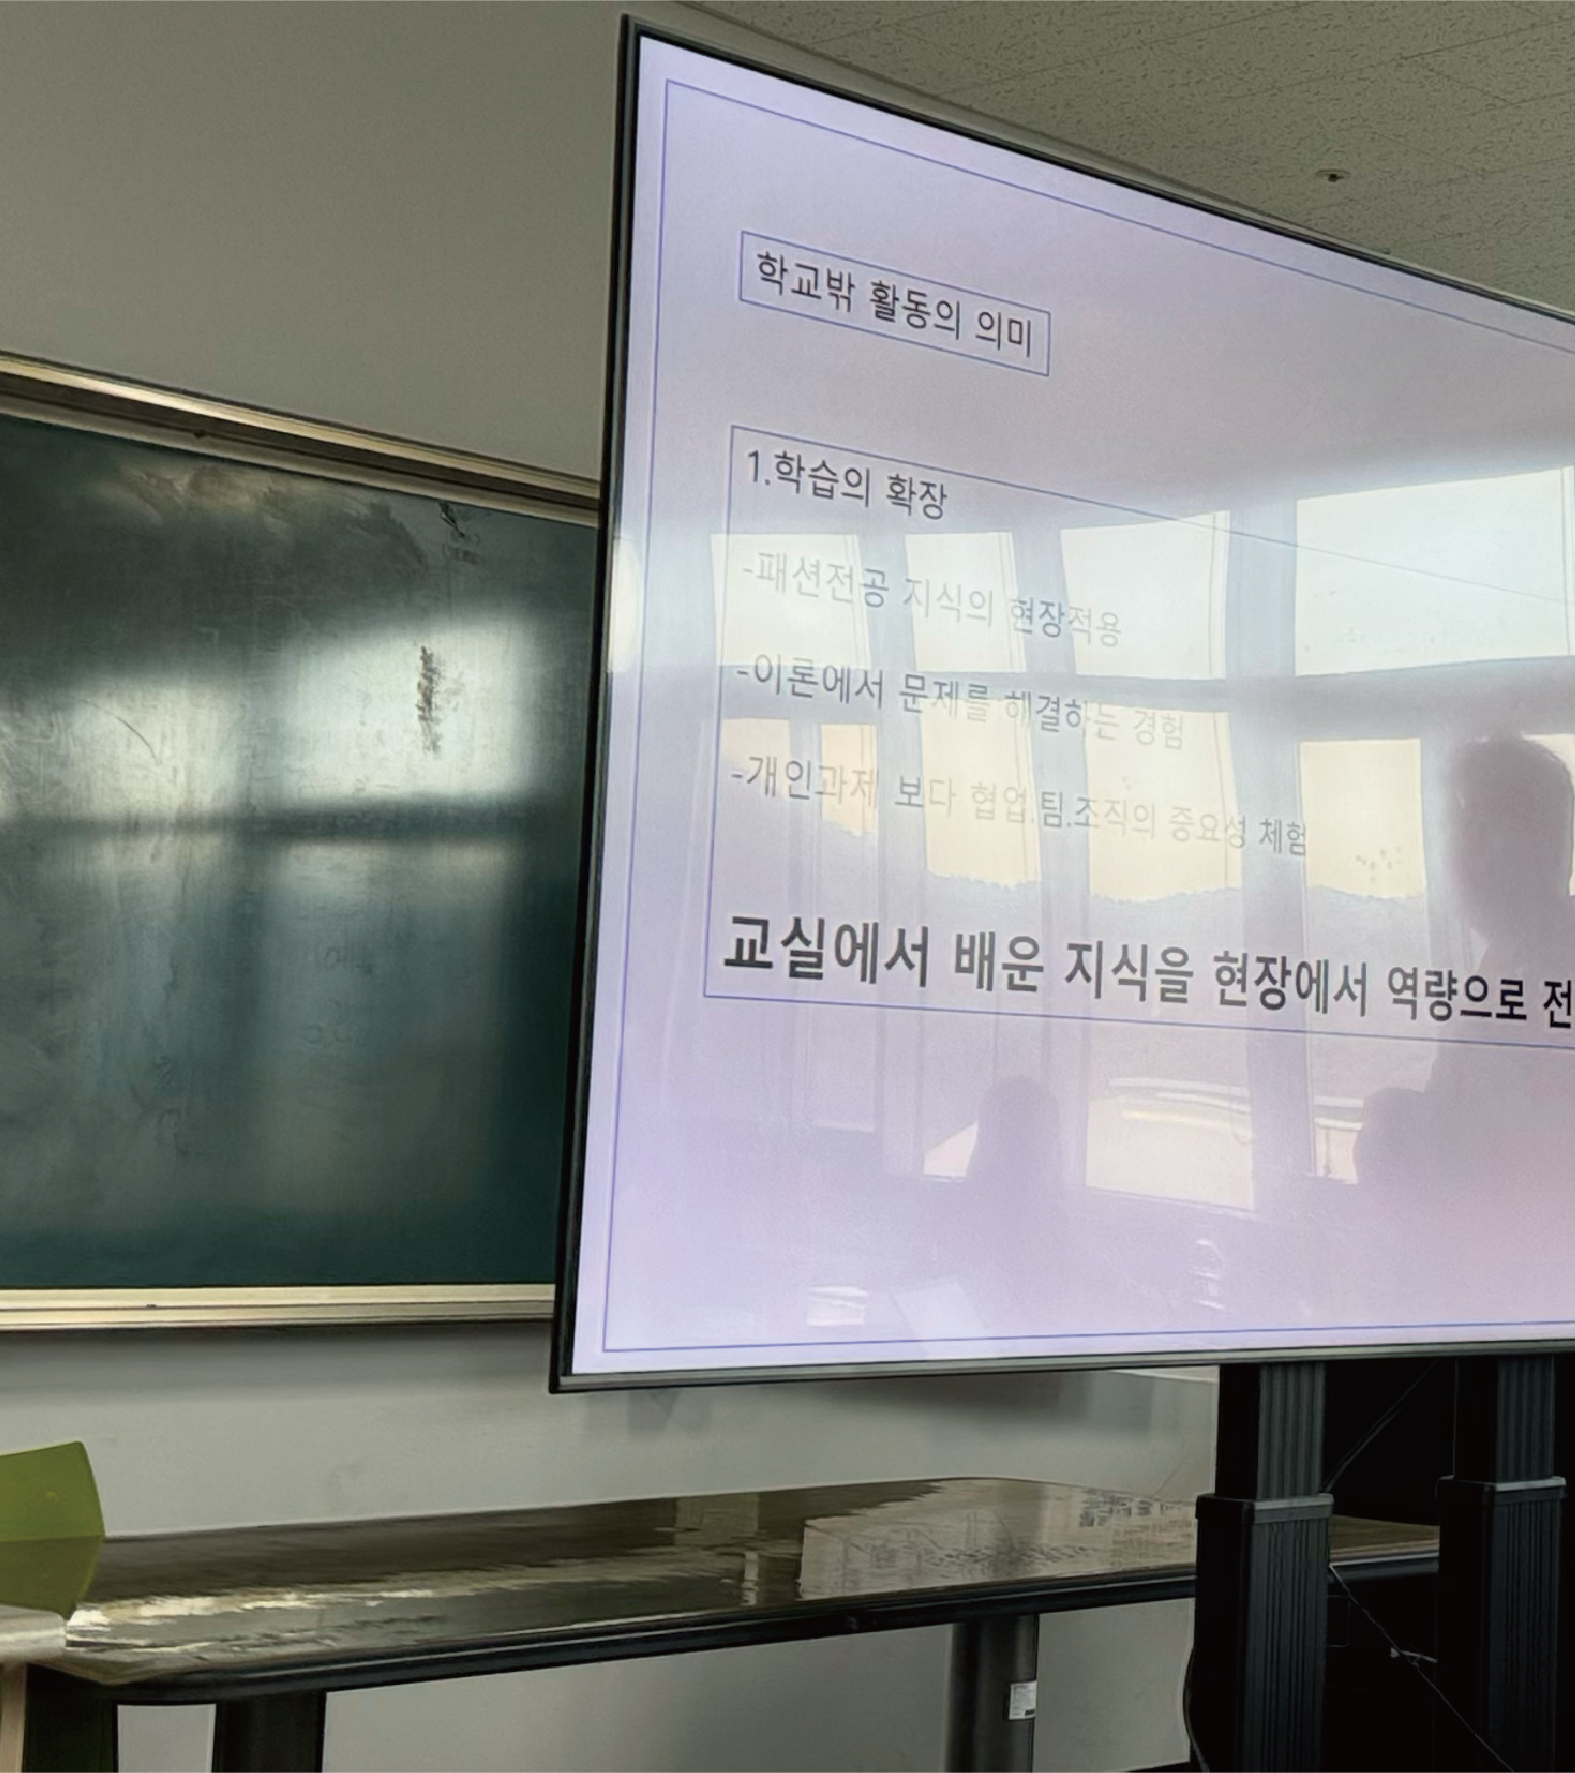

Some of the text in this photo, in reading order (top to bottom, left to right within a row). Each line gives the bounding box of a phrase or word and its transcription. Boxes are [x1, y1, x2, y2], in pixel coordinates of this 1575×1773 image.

[757, 251, 1031, 357] 학교밖 활동의 의미
[747, 450, 947, 520] 1.학습의 확장
[742, 552, 1121, 647] -패션전공 지식의 현장적용
[736, 653, 1183, 750] -이론에서 문제를 해결하는 경험
[731, 755, 878, 809] -개인과제
[894, 775, 956, 817] 보다
[1168, 806, 1246, 849] 중요성
[1259, 818, 1307, 857] 체험
[723, 915, 929, 988] 교실에서
[954, 930, 1044, 992] 배운
[1065, 940, 1194, 1004] 지식을
[1213, 950, 1367, 1018] 현장에서
[1387, 966, 1528, 1022] 역량으로
